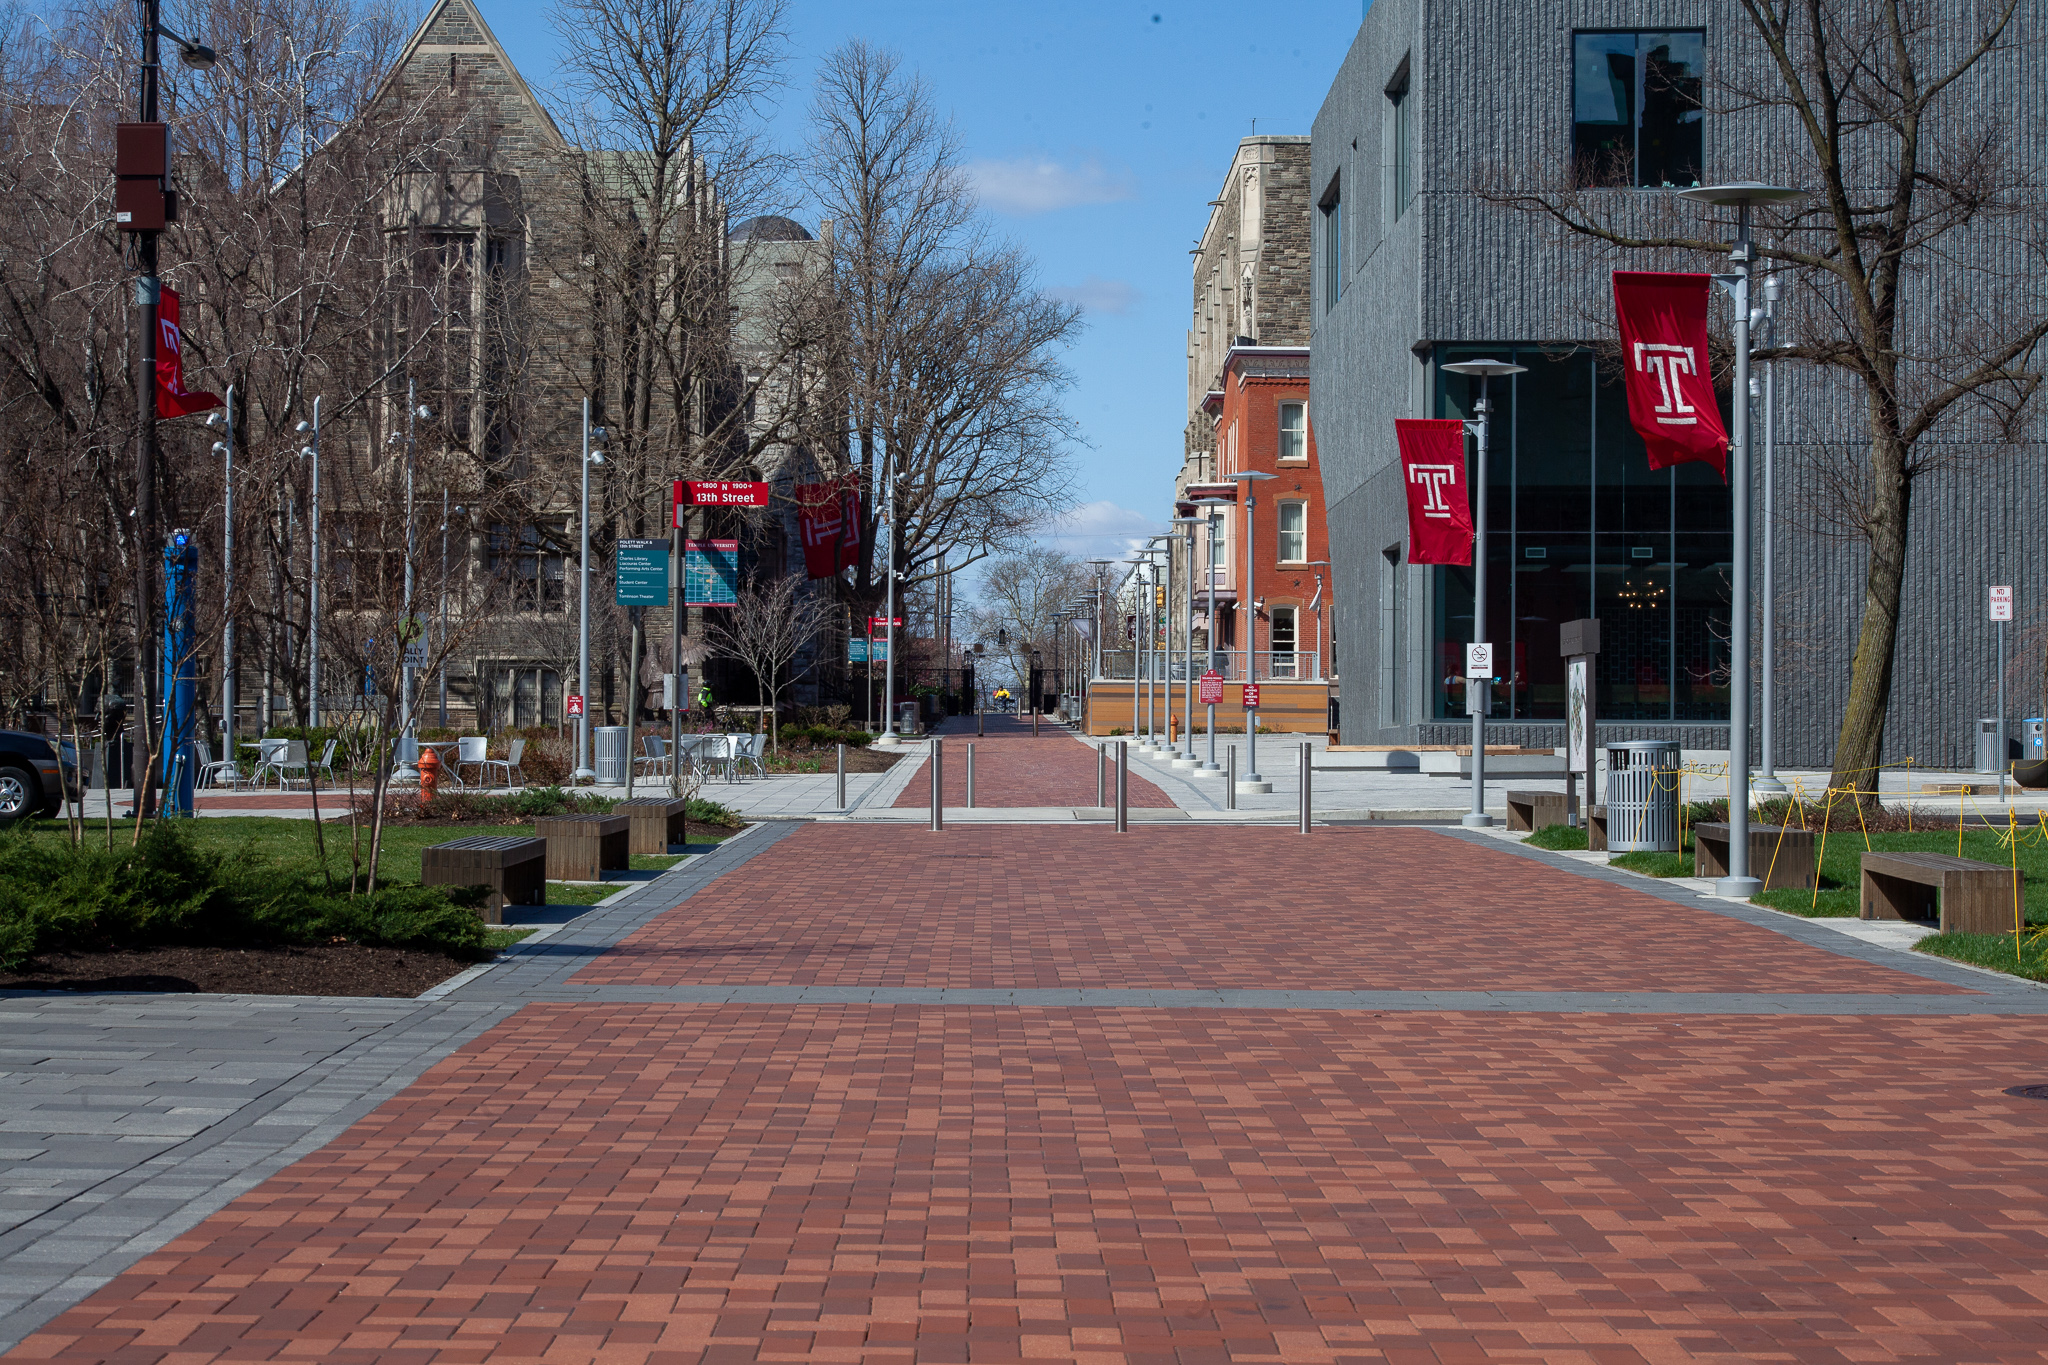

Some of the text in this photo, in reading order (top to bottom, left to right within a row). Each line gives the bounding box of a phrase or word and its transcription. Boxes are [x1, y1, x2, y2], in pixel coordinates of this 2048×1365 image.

[1633, 342, 1698, 425] T
[721, 483, 728, 491] N
[1408, 463, 1456, 518] T
[696, 492, 754, 502] 13th Street
[403, 647, 423, 655] ALLY
